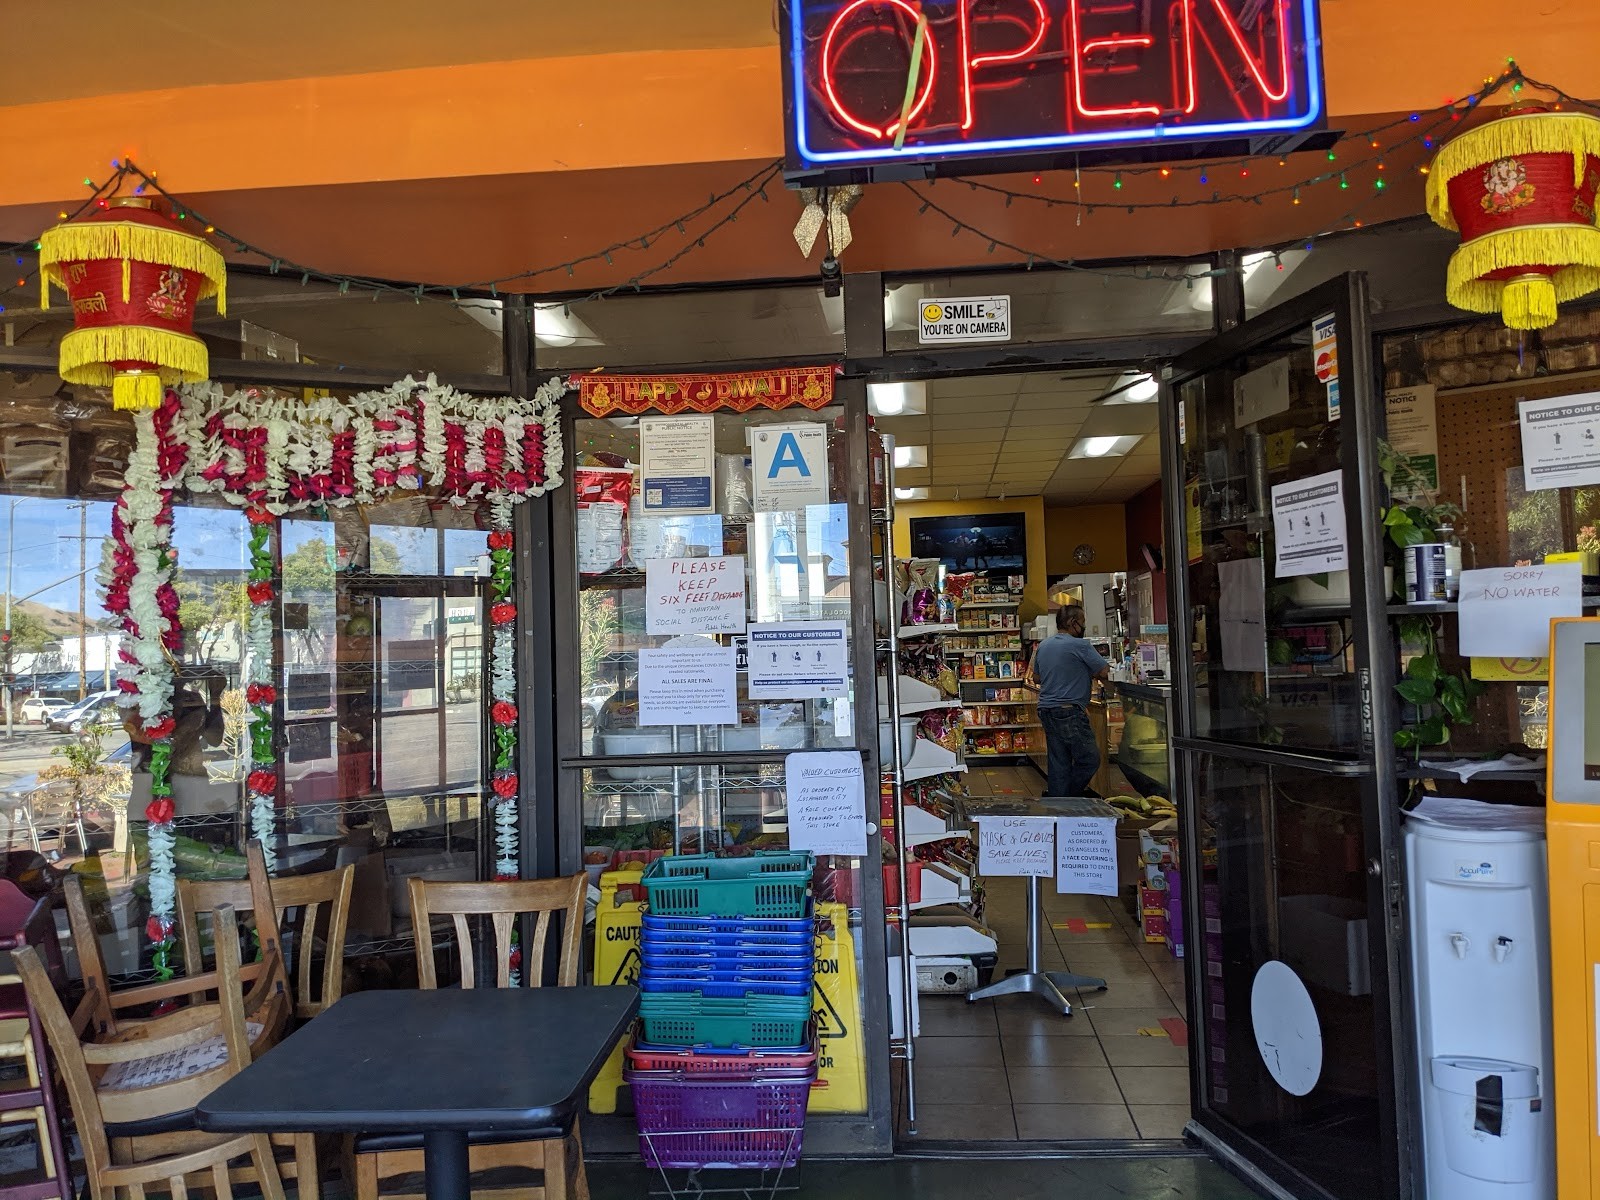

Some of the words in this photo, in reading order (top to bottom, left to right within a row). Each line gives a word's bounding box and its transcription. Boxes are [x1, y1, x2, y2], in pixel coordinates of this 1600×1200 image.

[821, 0, 1292, 140] OPEN
[944, 304, 984, 319] SMILE
[923, 324, 954, 335] YOU'RE
[955, 323, 968, 334] ON
[970, 322, 1006, 334] CAMERA
[624, 379, 696, 401] HAPPY
[716, 376, 787, 398] DIWALI
[1389, 396, 1417, 404] NOTICE
[767, 432, 812, 479] A
[1276, 496, 1291, 504] NOTICE
[1309, 485, 1337, 497] CUSTOMERS
[672, 561, 726, 574] PLEASE
[1504, 570, 1544, 581] SORRY
[678, 578, 717, 592] KEEP
[660, 595, 680, 605] SIX
[685, 592, 710, 604] FEET
[1484, 587, 1508, 600] NO
[1513, 586, 1560, 597] WATER
[1361, 671, 1373, 734] PUSH
[1003, 820, 1026, 828] USE
[980, 831, 1006, 847] MASK
[1020, 831, 1054, 844] GLOVES
[987, 850, 1010, 859] SAVE
[1014, 849, 1048, 859] LIVES
[1458, 865, 1494, 875] AccuPure
